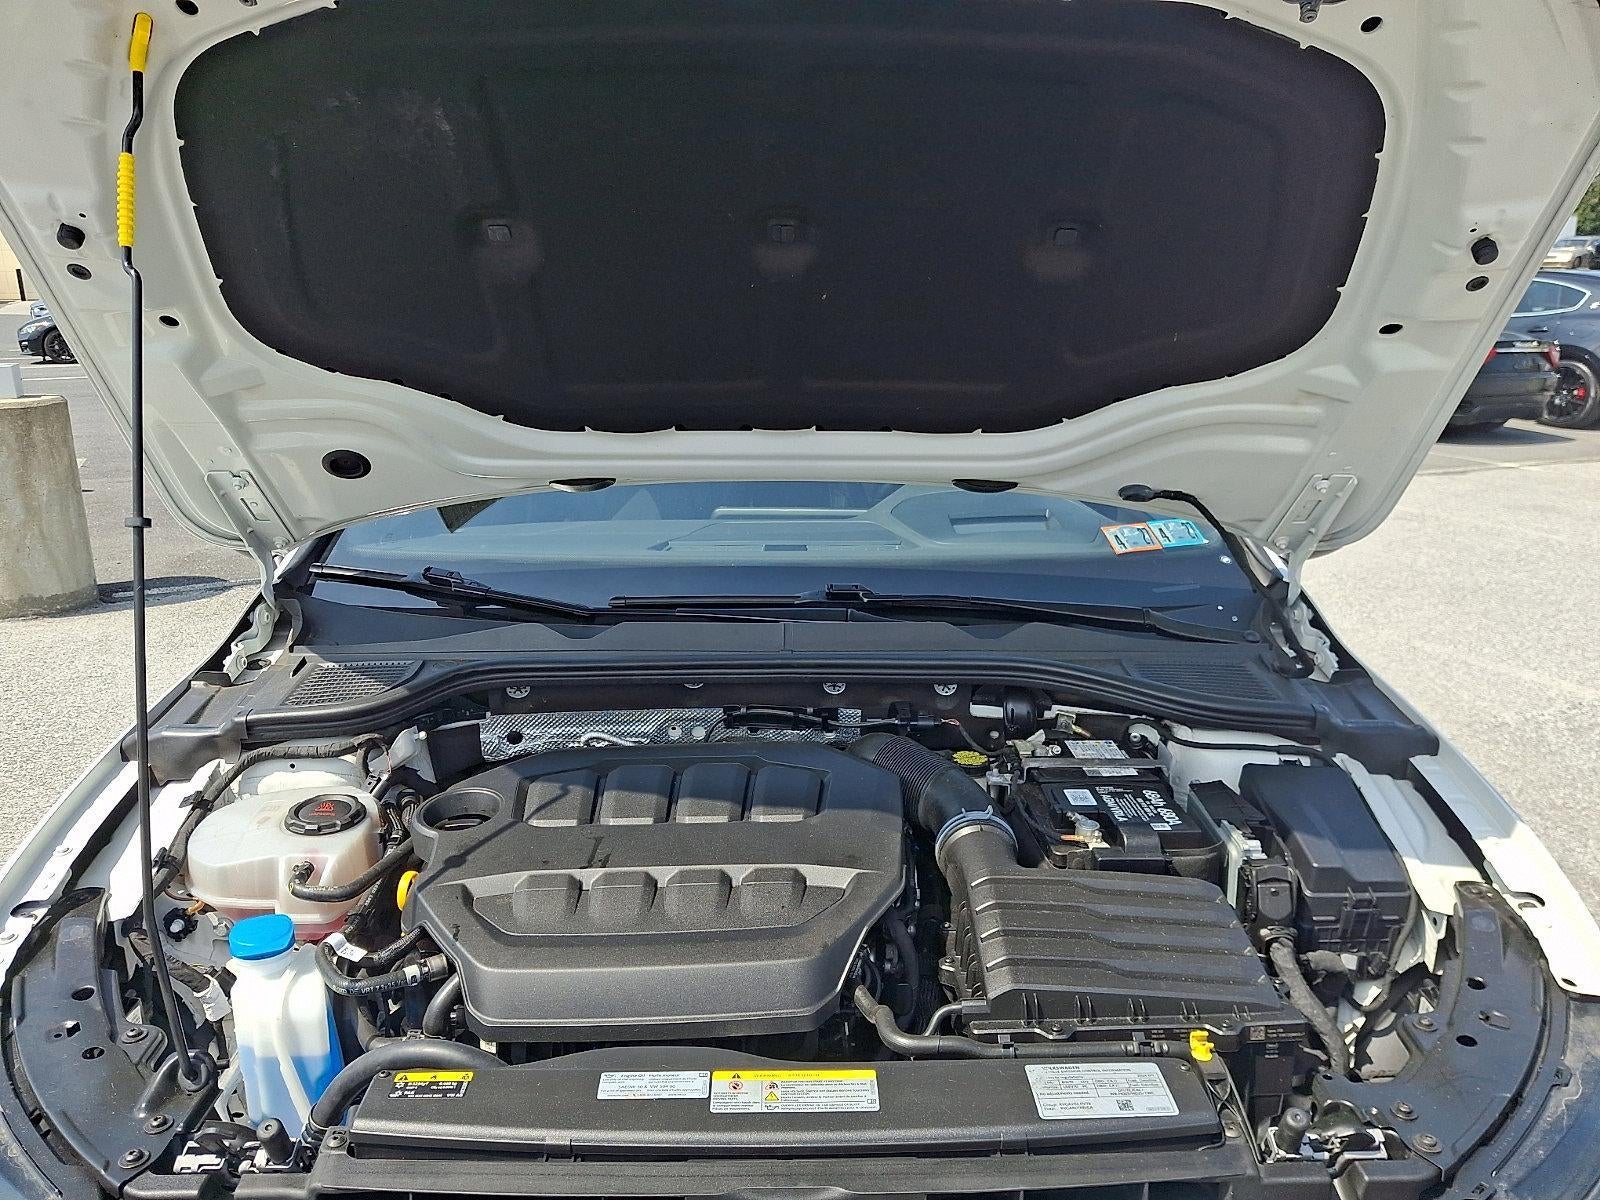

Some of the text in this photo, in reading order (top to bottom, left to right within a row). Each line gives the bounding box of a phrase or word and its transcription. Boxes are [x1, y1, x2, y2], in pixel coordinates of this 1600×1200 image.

[1114, 534, 1128, 549] 4
[1158, 527, 1172, 542] 4
[1142, 789, 1167, 807] 68Ah
[1157, 808, 1182, 826] 680A
